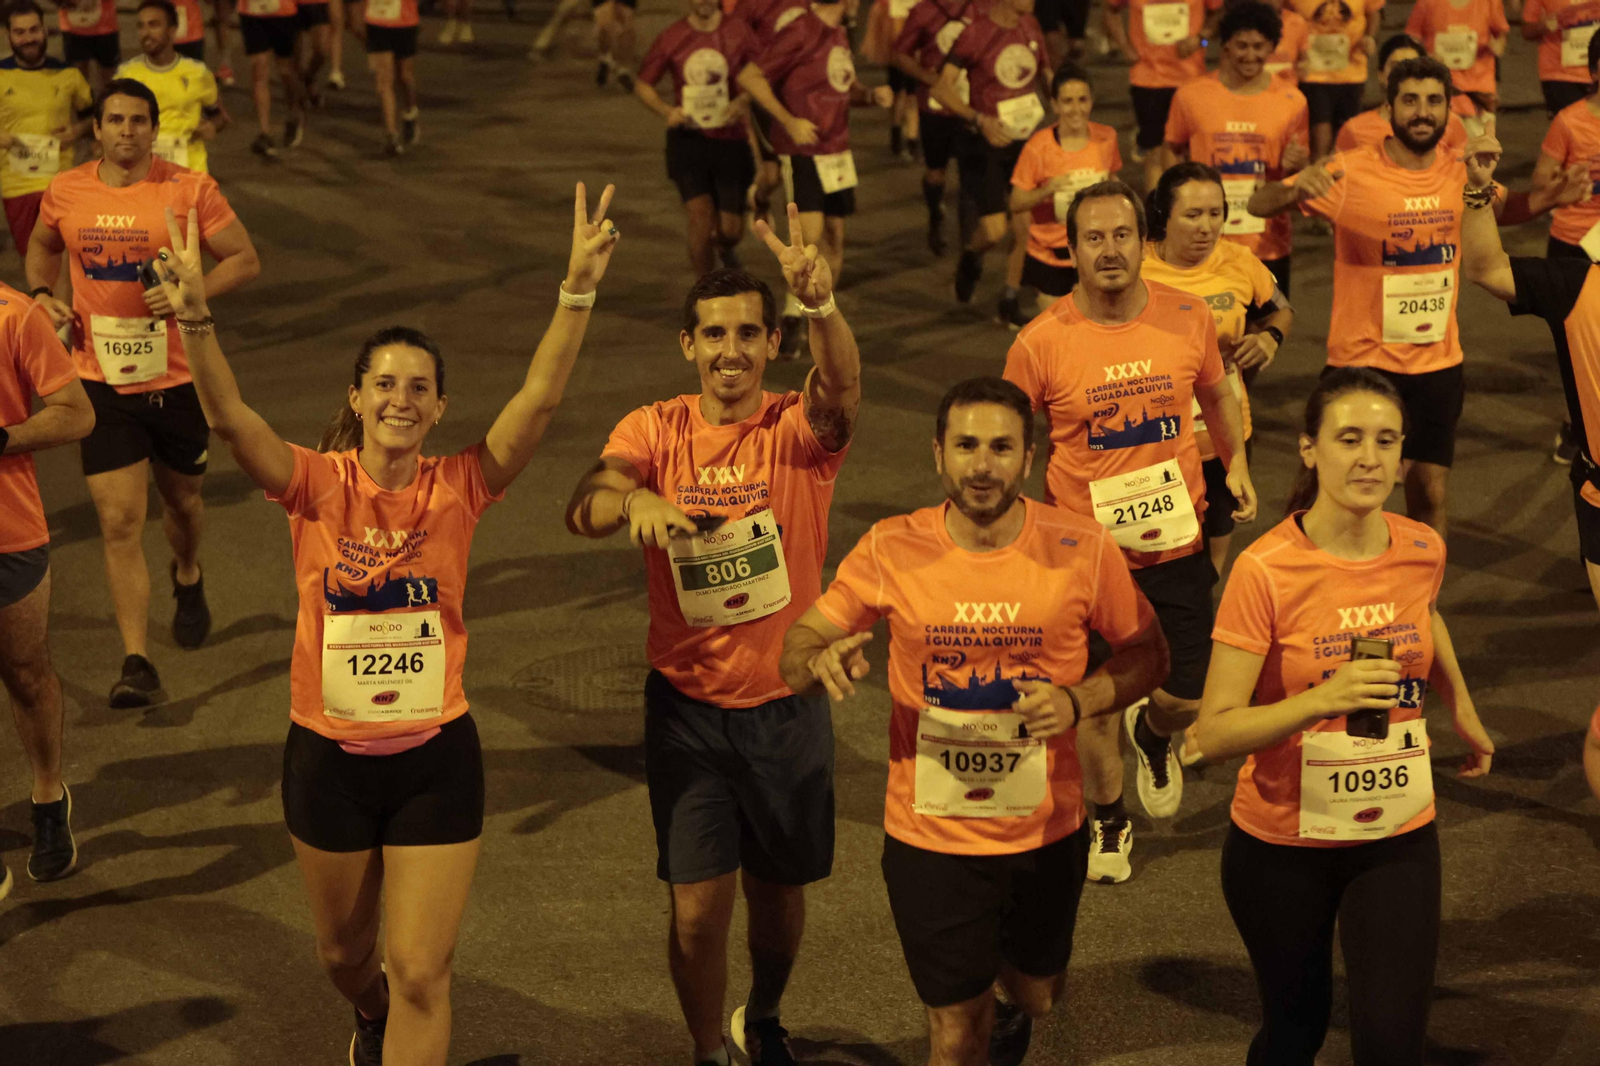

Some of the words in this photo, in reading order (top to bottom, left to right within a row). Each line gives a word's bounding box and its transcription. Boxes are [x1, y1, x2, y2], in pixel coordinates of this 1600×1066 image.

[1403, 196, 1440, 211] XXXV
[96, 214, 136, 228] XXXV
[82, 234, 149, 242] GUADALQUIVIR
[1399, 297, 1445, 314] 20438
[104, 341, 153, 356] 16925
[1103, 359, 1152, 382] XXXV
[1086, 382, 1124, 395] CARRERA
[1127, 374, 1172, 386] NOCTURNA
[1093, 382, 1174, 403] GUADALQUIVIR
[697, 464, 745, 485] XXXV
[678, 485, 718, 496] CARRERA
[721, 479, 767, 495] NOCTURNA
[683, 489, 769, 507] GUADALQUIVIR
[1113, 495, 1174, 525] 21248
[338, 538, 381, 558] CARRERA
[705, 556, 752, 585] 806
[712, 583, 742, 594] MORGADO
[726, 596, 745, 607] KH7
[953, 602, 1021, 623] XXXV
[1337, 602, 1395, 629] XXXV
[925, 625, 977, 634] CARRERA
[982, 626, 1043, 635] NOCTURNA
[1367, 623, 1417, 638] NOCTURNA
[932, 636, 1043, 647] GUADALQUIVIR
[347, 652, 424, 676] 12246
[374, 694, 395, 702] KH7
[940, 749, 1021, 773] 10937
[1328, 765, 1409, 793] 10936
